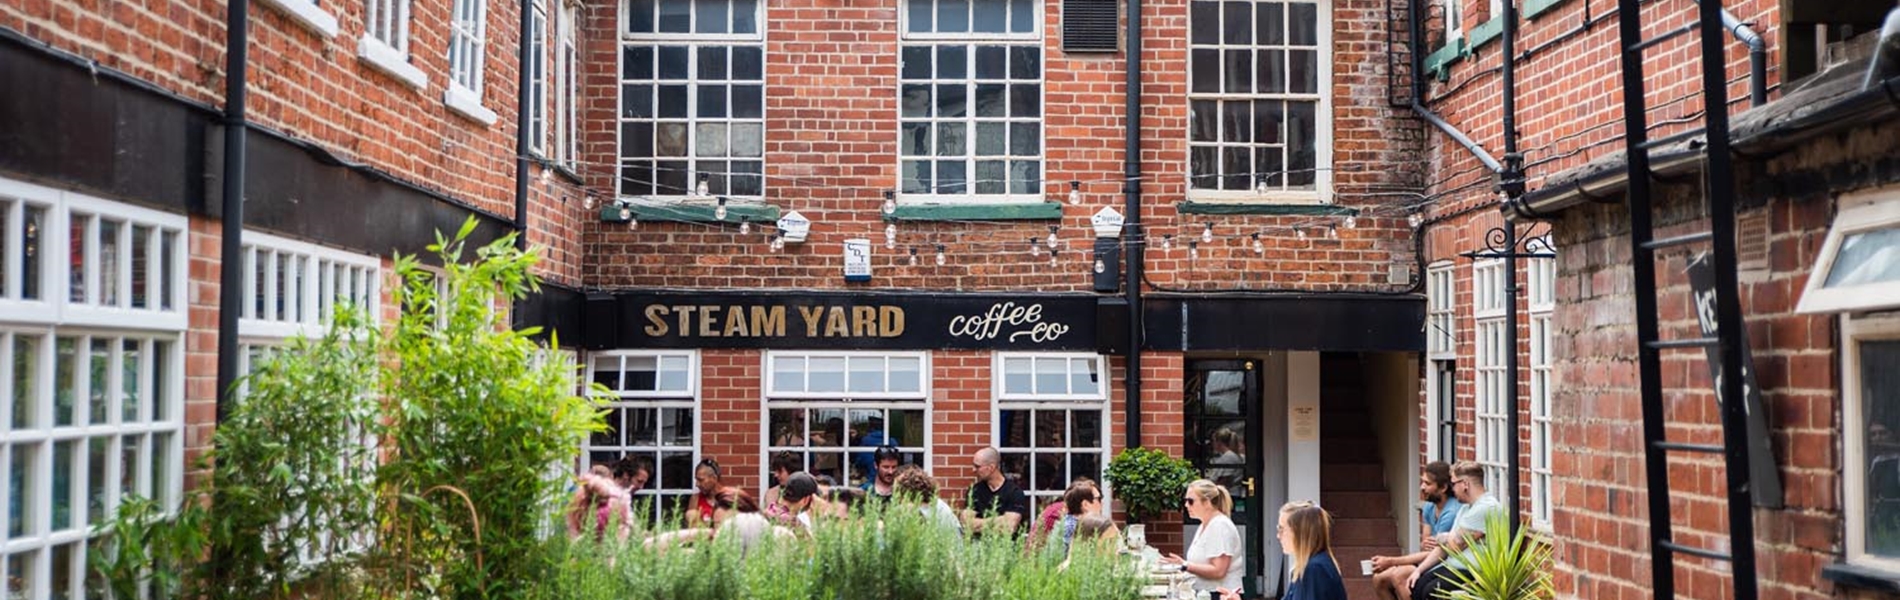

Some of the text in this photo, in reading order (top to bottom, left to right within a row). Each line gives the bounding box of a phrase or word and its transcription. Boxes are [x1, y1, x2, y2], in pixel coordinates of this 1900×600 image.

[644, 303, 906, 338] STEAM YARD
[949, 301, 1042, 340] coffee
[1009, 322, 1069, 342] co
